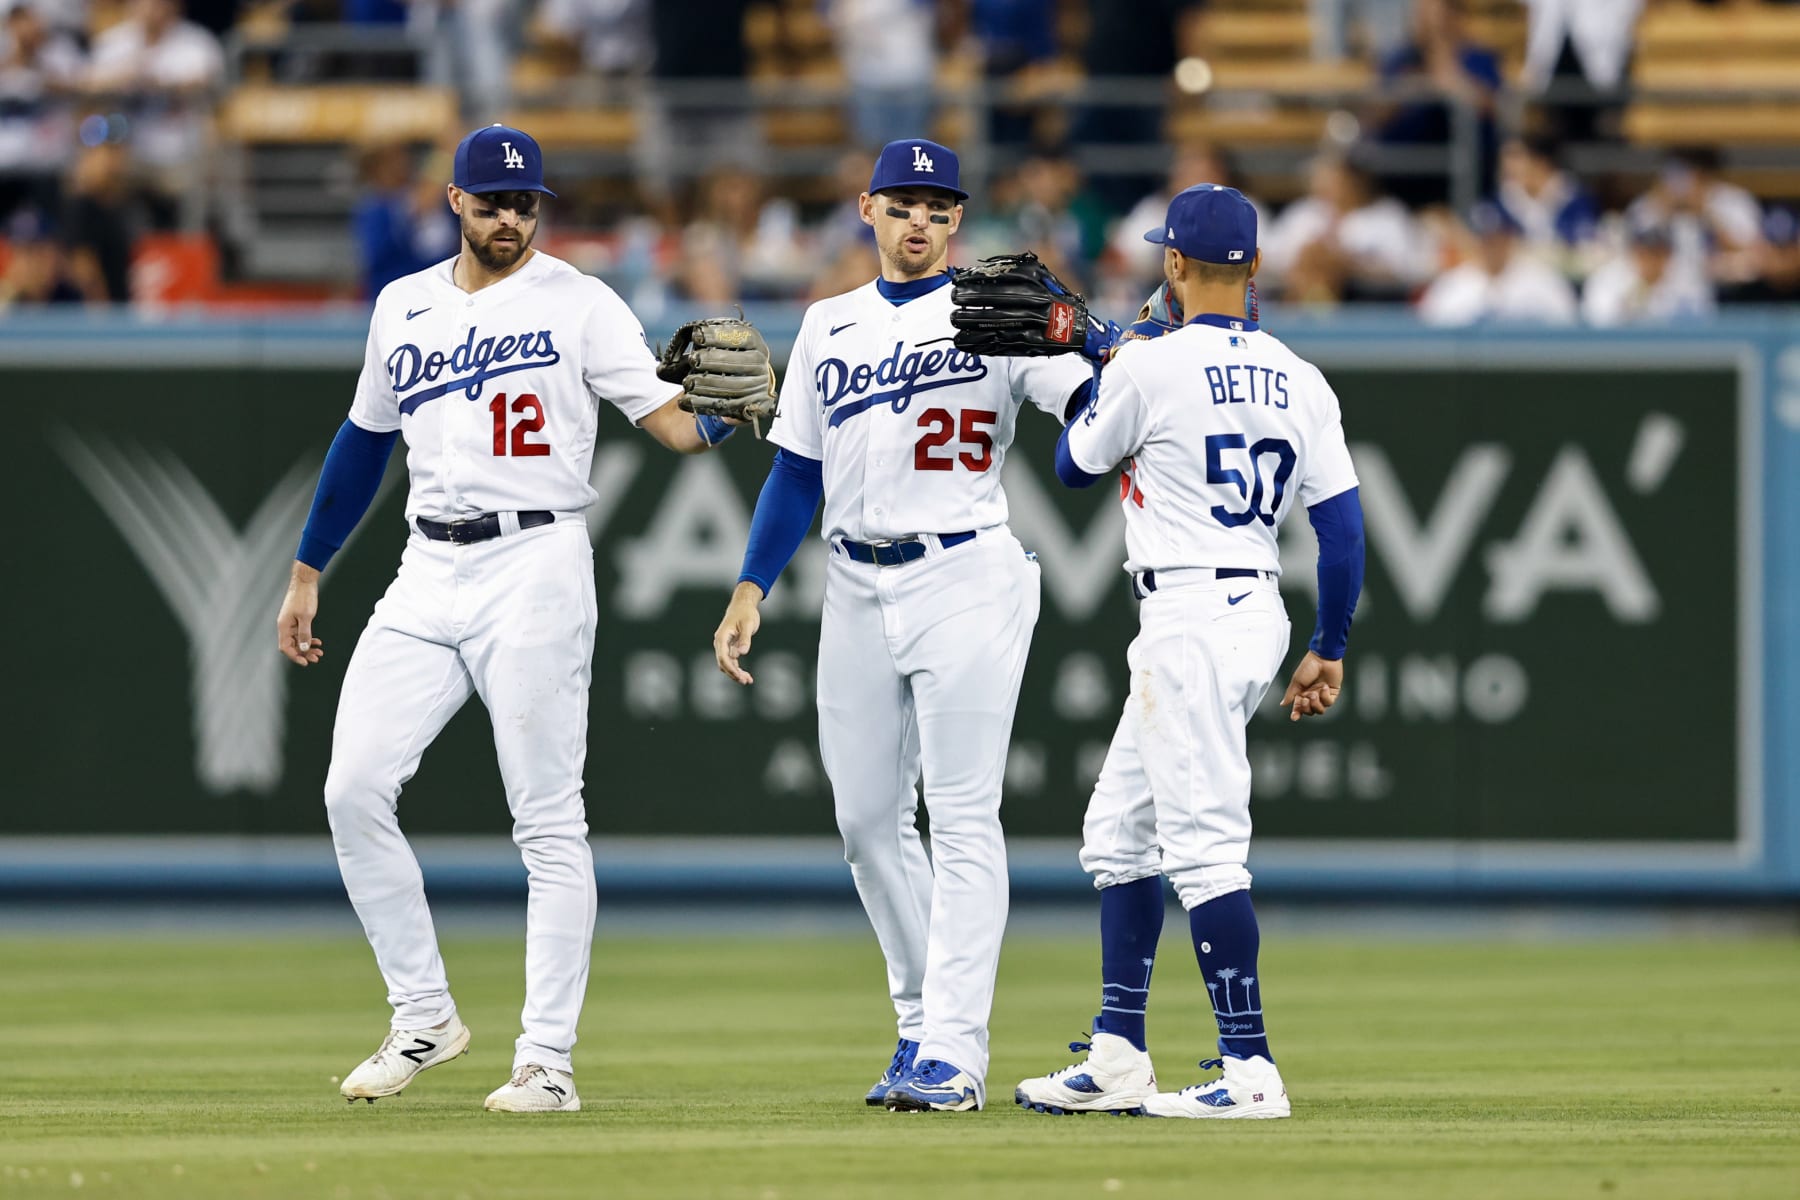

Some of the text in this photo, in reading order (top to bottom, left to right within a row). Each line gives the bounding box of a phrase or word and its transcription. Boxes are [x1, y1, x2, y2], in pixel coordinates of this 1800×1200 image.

[502, 142, 525, 169] LA
[912, 146, 934, 173] LA
[388, 326, 560, 416] Dodgers
[816, 341, 987, 428] Dodgers
[1205, 365, 1288, 409] BETTS
[489, 392, 550, 456] 12
[915, 408, 997, 472] 25
[1205, 434, 1297, 528] 50
[1252, 1092, 1265, 1103] 50
